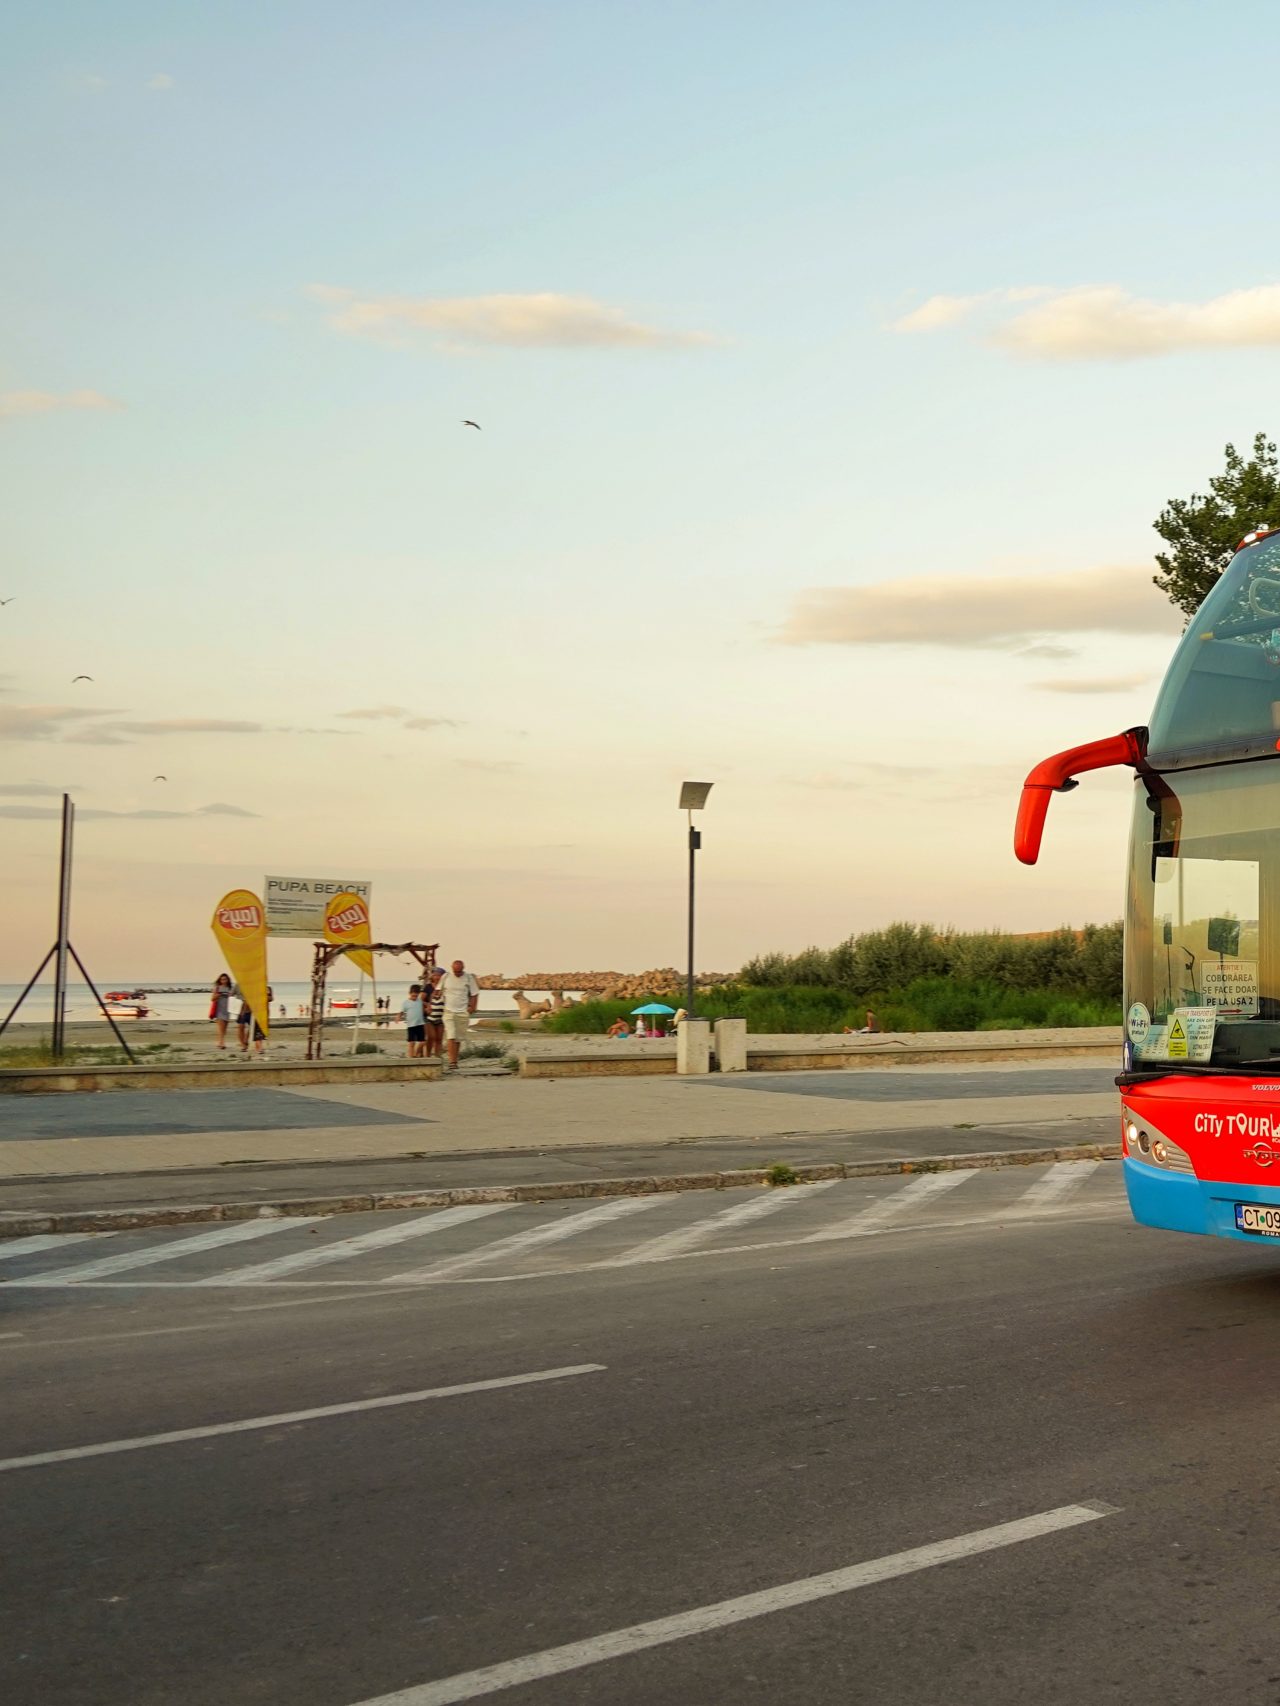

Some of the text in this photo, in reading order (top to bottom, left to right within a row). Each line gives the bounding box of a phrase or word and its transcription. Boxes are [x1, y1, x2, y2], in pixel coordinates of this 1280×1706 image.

[267, 880, 368, 896] PUPA BEACH
[1202, 985, 1257, 995] SE FACE DOAR
[1206, 998, 1216, 1006] PE
[1218, 997, 1228, 1006] LA
[1248, 997, 1254, 1005] 2
[1226, 1112, 1270, 1137] TOUR
